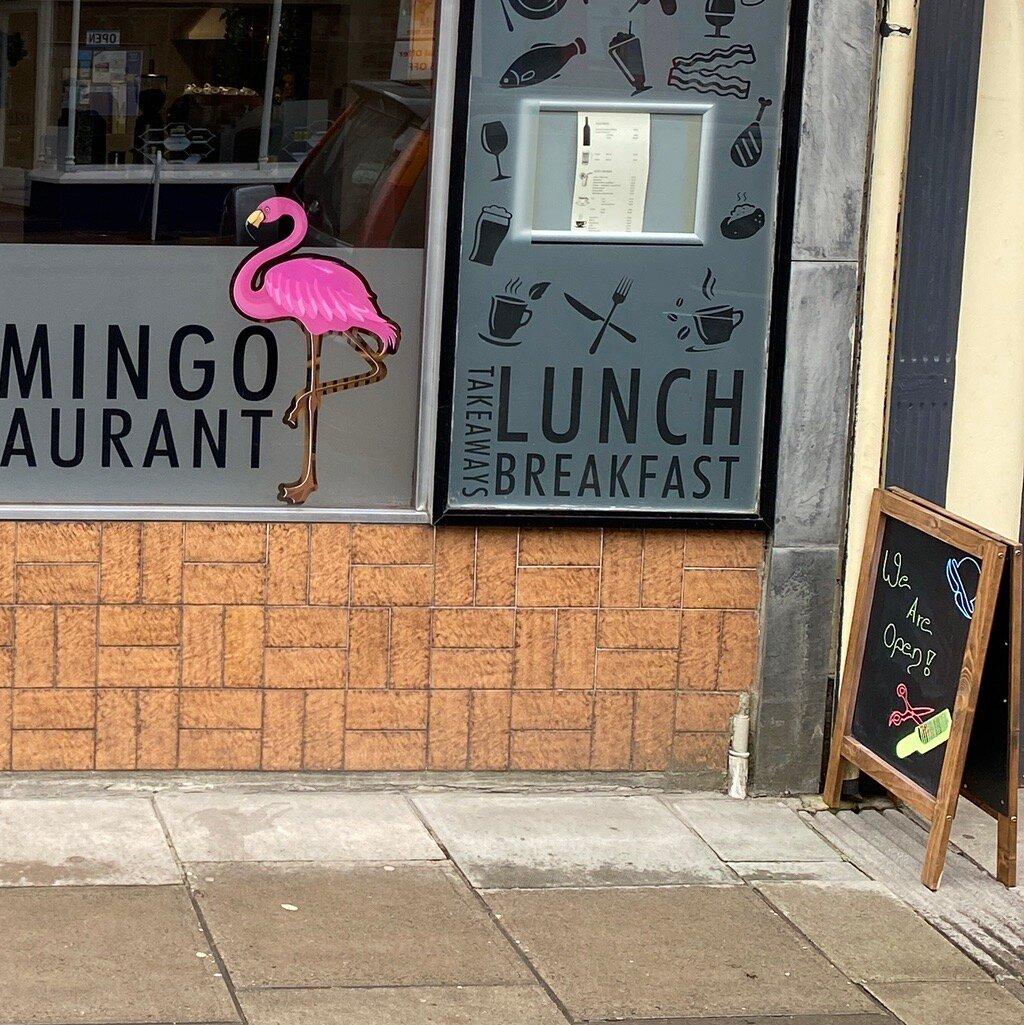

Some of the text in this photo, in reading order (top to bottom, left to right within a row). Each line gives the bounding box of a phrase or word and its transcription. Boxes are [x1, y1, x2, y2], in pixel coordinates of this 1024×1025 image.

[496, 366, 744, 446] LUNCH
[461, 366, 495, 498] TAKEAWAYS
[494, 453, 740, 499] BREAKFAST
[882, 549, 912, 590] We
[906, 596, 933, 635] Are
[883, 623, 937, 677] Open!
